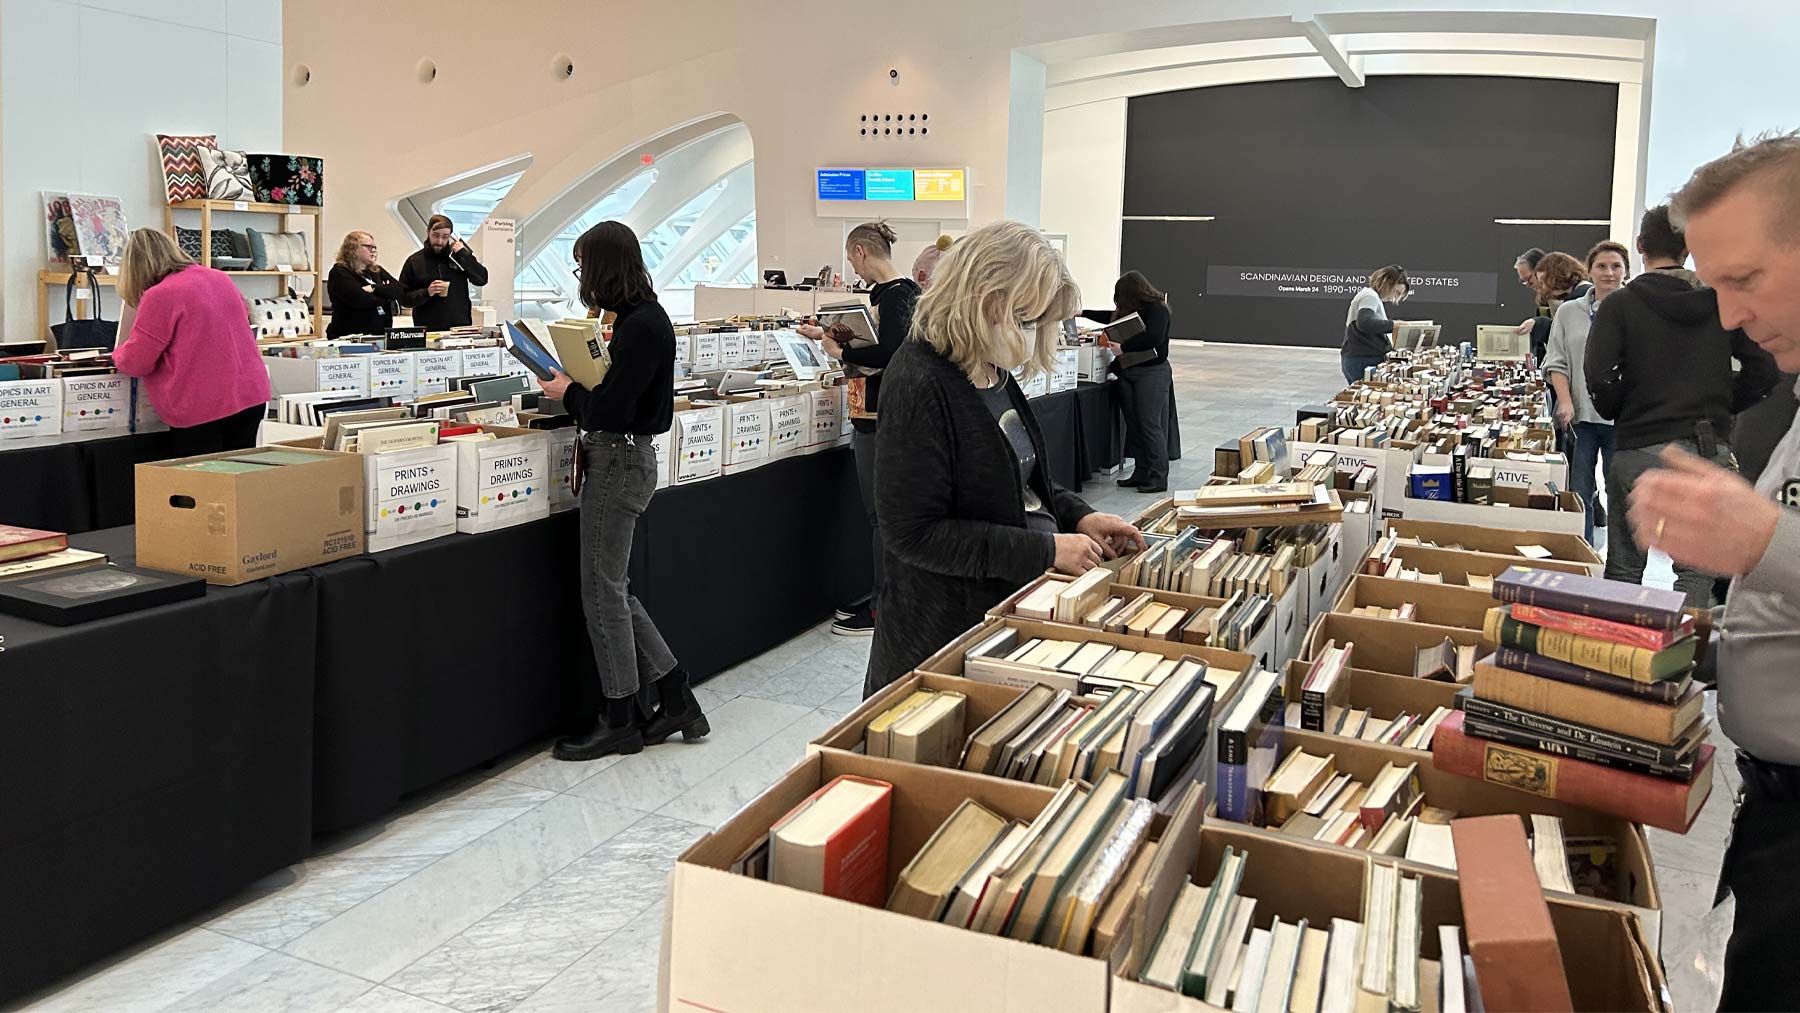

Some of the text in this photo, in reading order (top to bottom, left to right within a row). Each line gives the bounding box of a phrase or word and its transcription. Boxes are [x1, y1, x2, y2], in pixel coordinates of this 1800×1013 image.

[1240, 272, 1308, 282] SCANDINAVIAN
[1309, 274, 1344, 283] DESIGN
[1345, 275, 1367, 284] AND
[1425, 277, 1459, 287] STATES
[1278, 285, 1295, 293] Opens
[322, 363, 342, 371] TOPICS
[69, 380, 121, 391] TOPICS IN ART
[0, 386, 51, 397] OPICS IN ART
[77, 392, 111, 401] GENERAL
[0, 398, 39, 408] GENERAL
[779, 407, 794, 418] PRINTS
[740, 414, 756, 423] PRINTS
[777, 416, 801, 429] DRAWINGS
[690, 423, 708, 433] PRINTS
[736, 424, 761, 435] DRAWINGS
[688, 434, 714, 445] DRAWINGS
[494, 456, 523, 470] PRINTS
[394, 466, 428, 481] PRINTS
[490, 468, 533, 485] DRAWINGS
[390, 479, 440, 497] DRAWINGS
[322, 541, 356, 556] ACID FREE
[242, 549, 277, 566] Gaylord
[189, 563, 227, 575] ACID FREE
[1503, 710, 1519, 722] The
[1521, 714, 1554, 732] Universe
[1556, 726, 1572, 738] and
[1574, 730, 1587, 742] Dr.
[1589, 733, 1622, 750] Einstein
[1538, 740, 1569, 755] KAFKA
